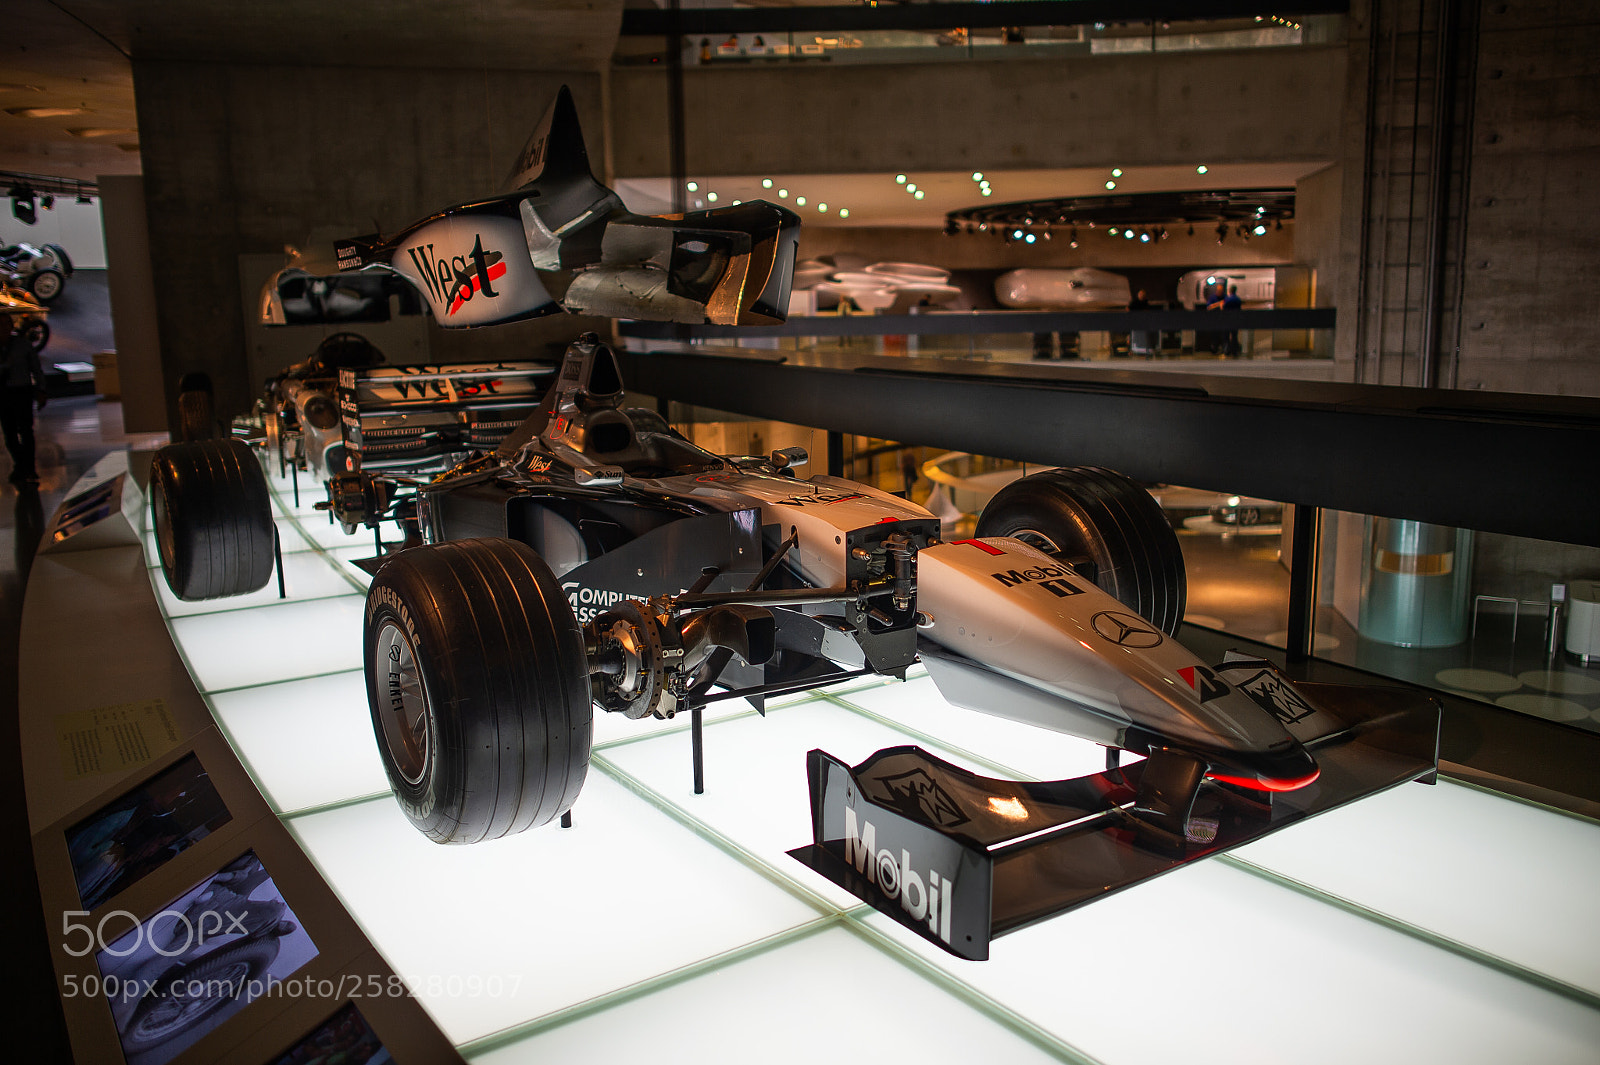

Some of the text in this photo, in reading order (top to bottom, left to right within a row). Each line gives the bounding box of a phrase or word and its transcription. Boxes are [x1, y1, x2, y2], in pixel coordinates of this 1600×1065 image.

[407, 234, 506, 317] West
[527, 455, 553, 473] West
[604, 470, 622, 479] Sun
[990, 564, 1079, 588] Mobil
[1038, 579, 1085, 598] 1
[366, 585, 422, 648] BRIDGESTONE
[845, 805, 953, 944] Mobil
